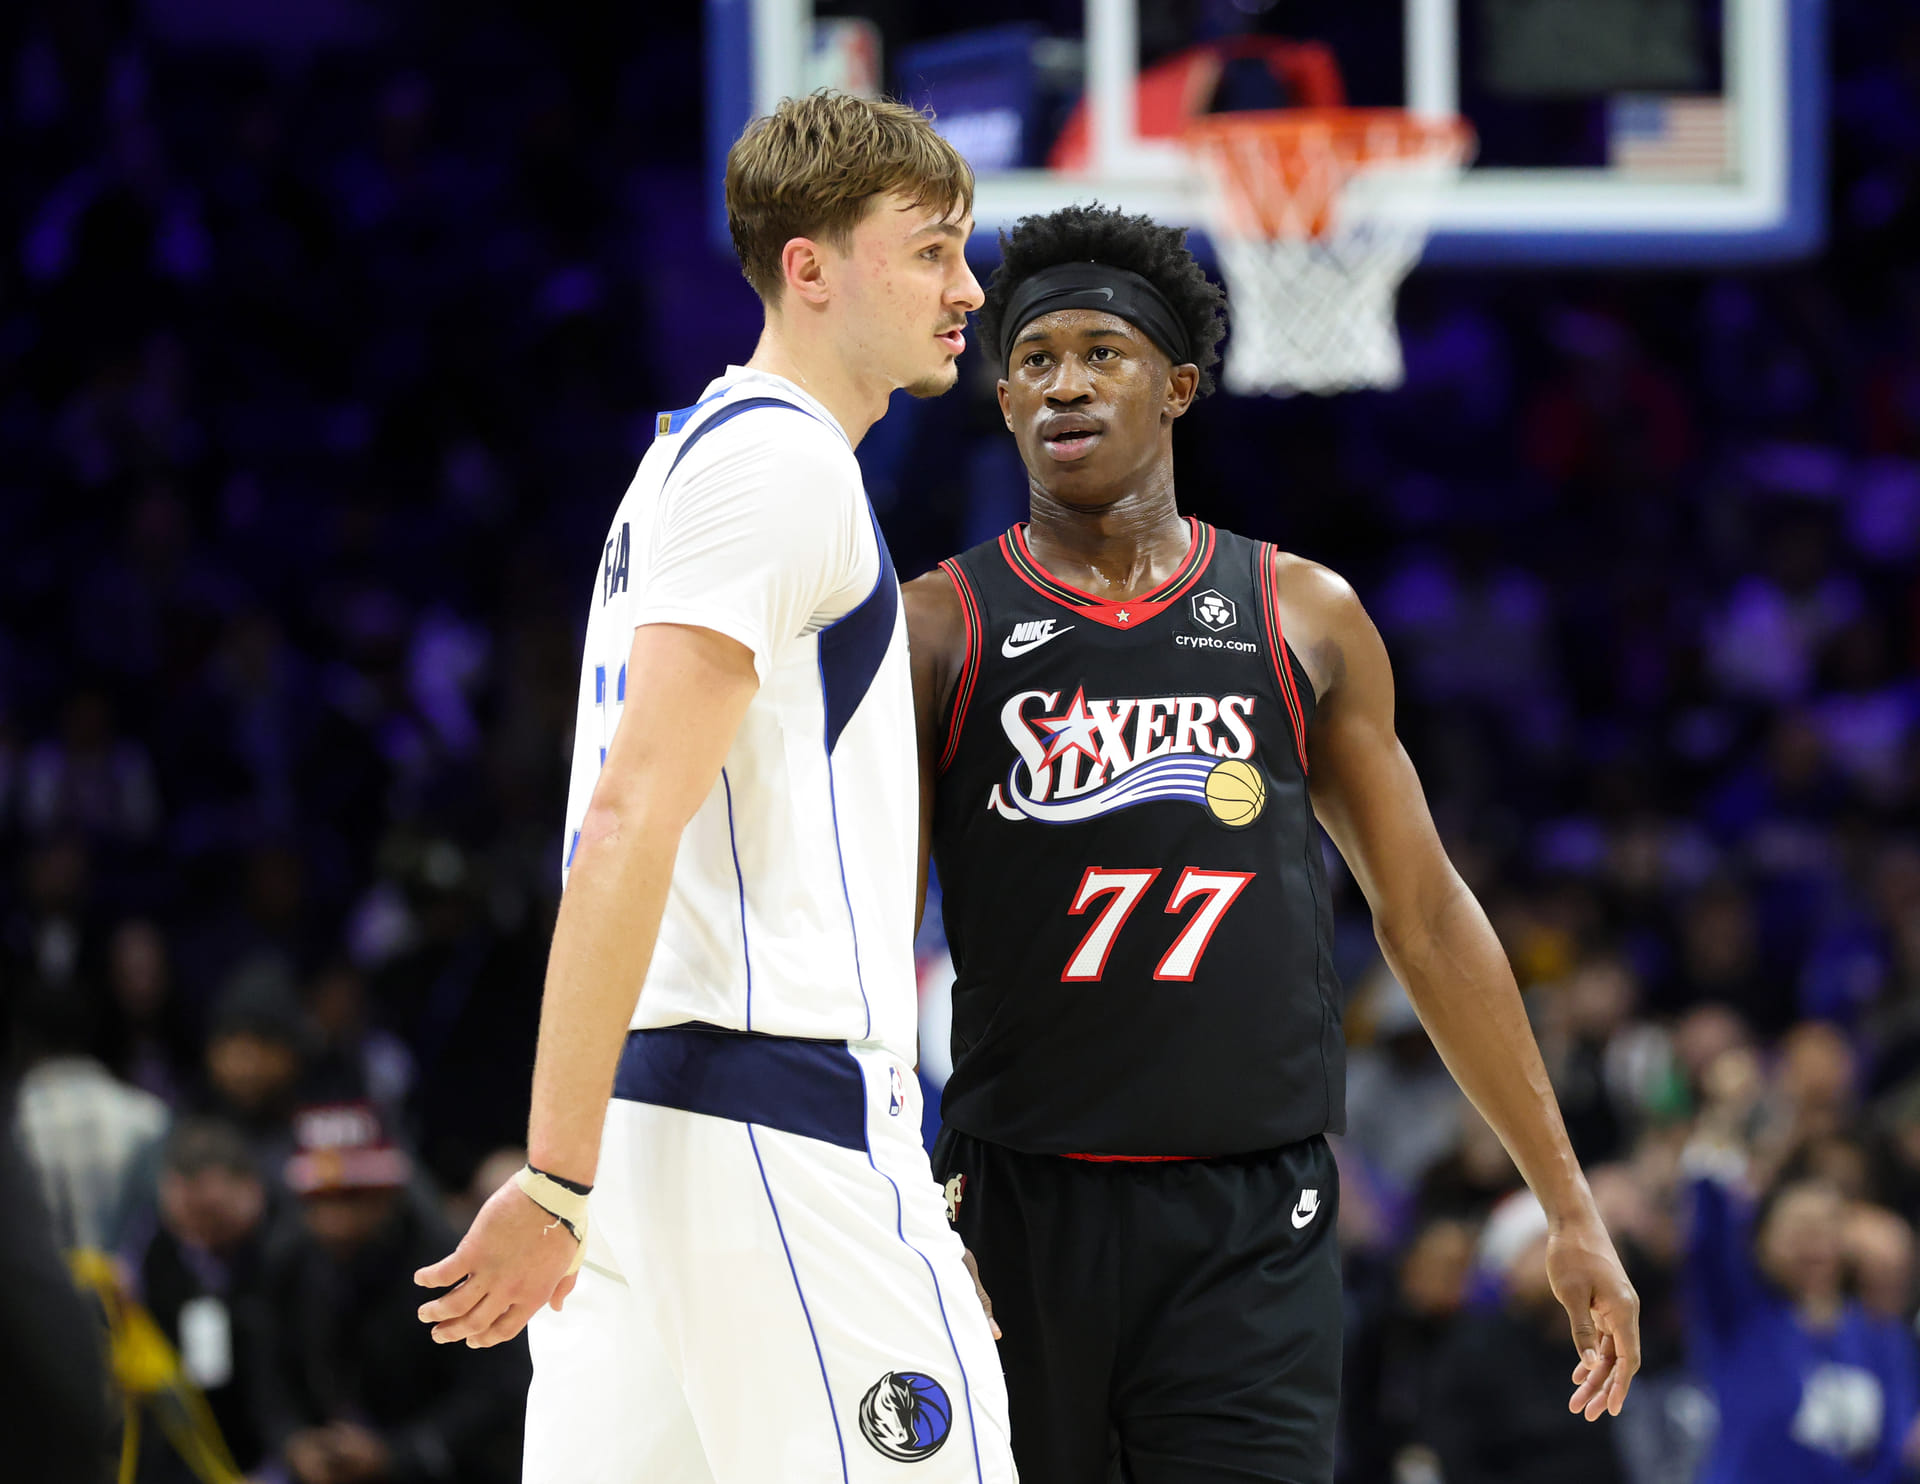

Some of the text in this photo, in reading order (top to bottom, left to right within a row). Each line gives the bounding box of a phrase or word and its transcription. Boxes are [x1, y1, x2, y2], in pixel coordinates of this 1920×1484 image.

[1009, 618, 1057, 643] NIKE
[1175, 635, 1257, 653] crypto.com
[988, 686, 1257, 820] SIXERS
[1060, 866, 1257, 982] 77
